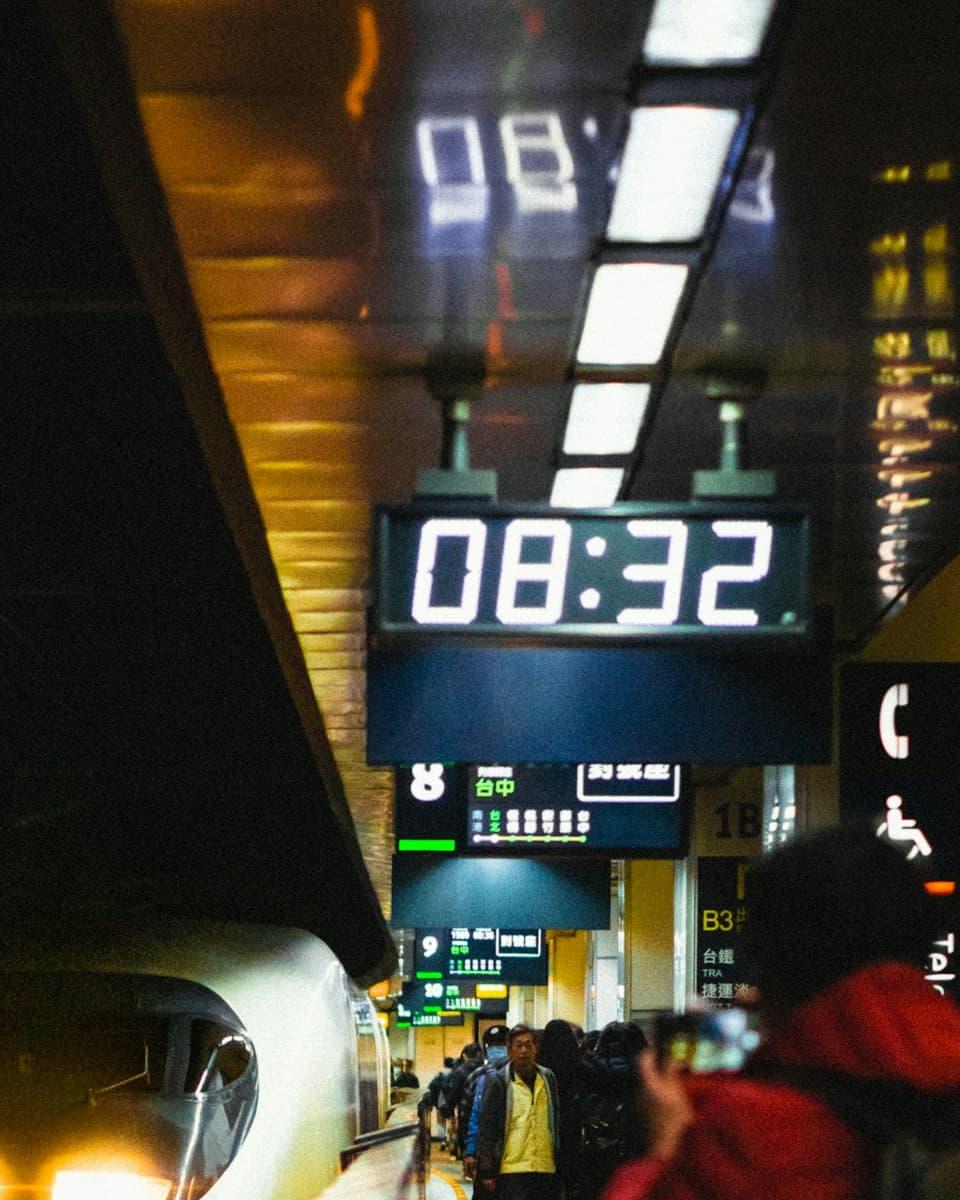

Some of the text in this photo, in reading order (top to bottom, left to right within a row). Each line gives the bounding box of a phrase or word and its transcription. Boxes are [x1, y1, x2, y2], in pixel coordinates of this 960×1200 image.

[411, 518, 773, 626] 08:32
[410, 763, 445, 801] 8
[475, 778, 515, 798] 台中
[702, 909, 733, 932] B3
[422, 936, 438, 958] 9
[702, 968, 723, 978] TRA
